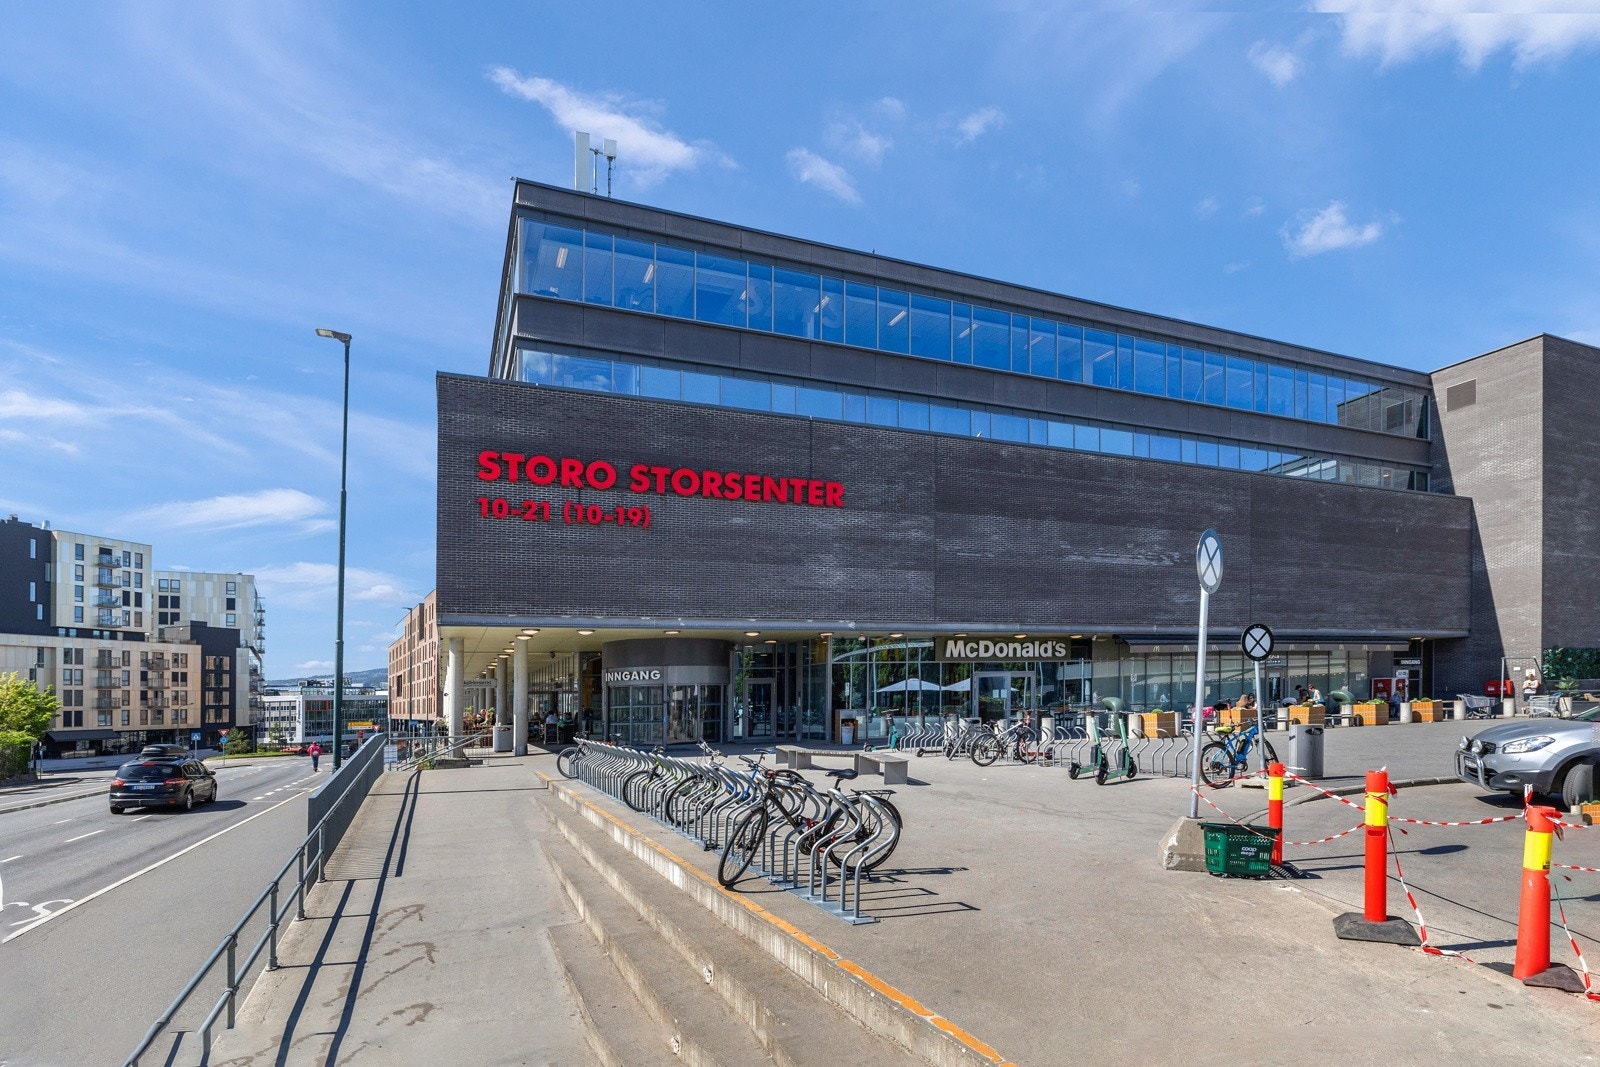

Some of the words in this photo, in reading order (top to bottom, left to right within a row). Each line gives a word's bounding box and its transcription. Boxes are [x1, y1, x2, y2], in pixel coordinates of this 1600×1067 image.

[477, 450, 617, 490] STORO
[629, 464, 846, 509] STORSENTER
[477, 496, 551, 522] 10-21
[563, 500, 651, 530] (10-19)
[945, 639, 1067, 659] McDonald's
[605, 670, 661, 682] INNGANG
